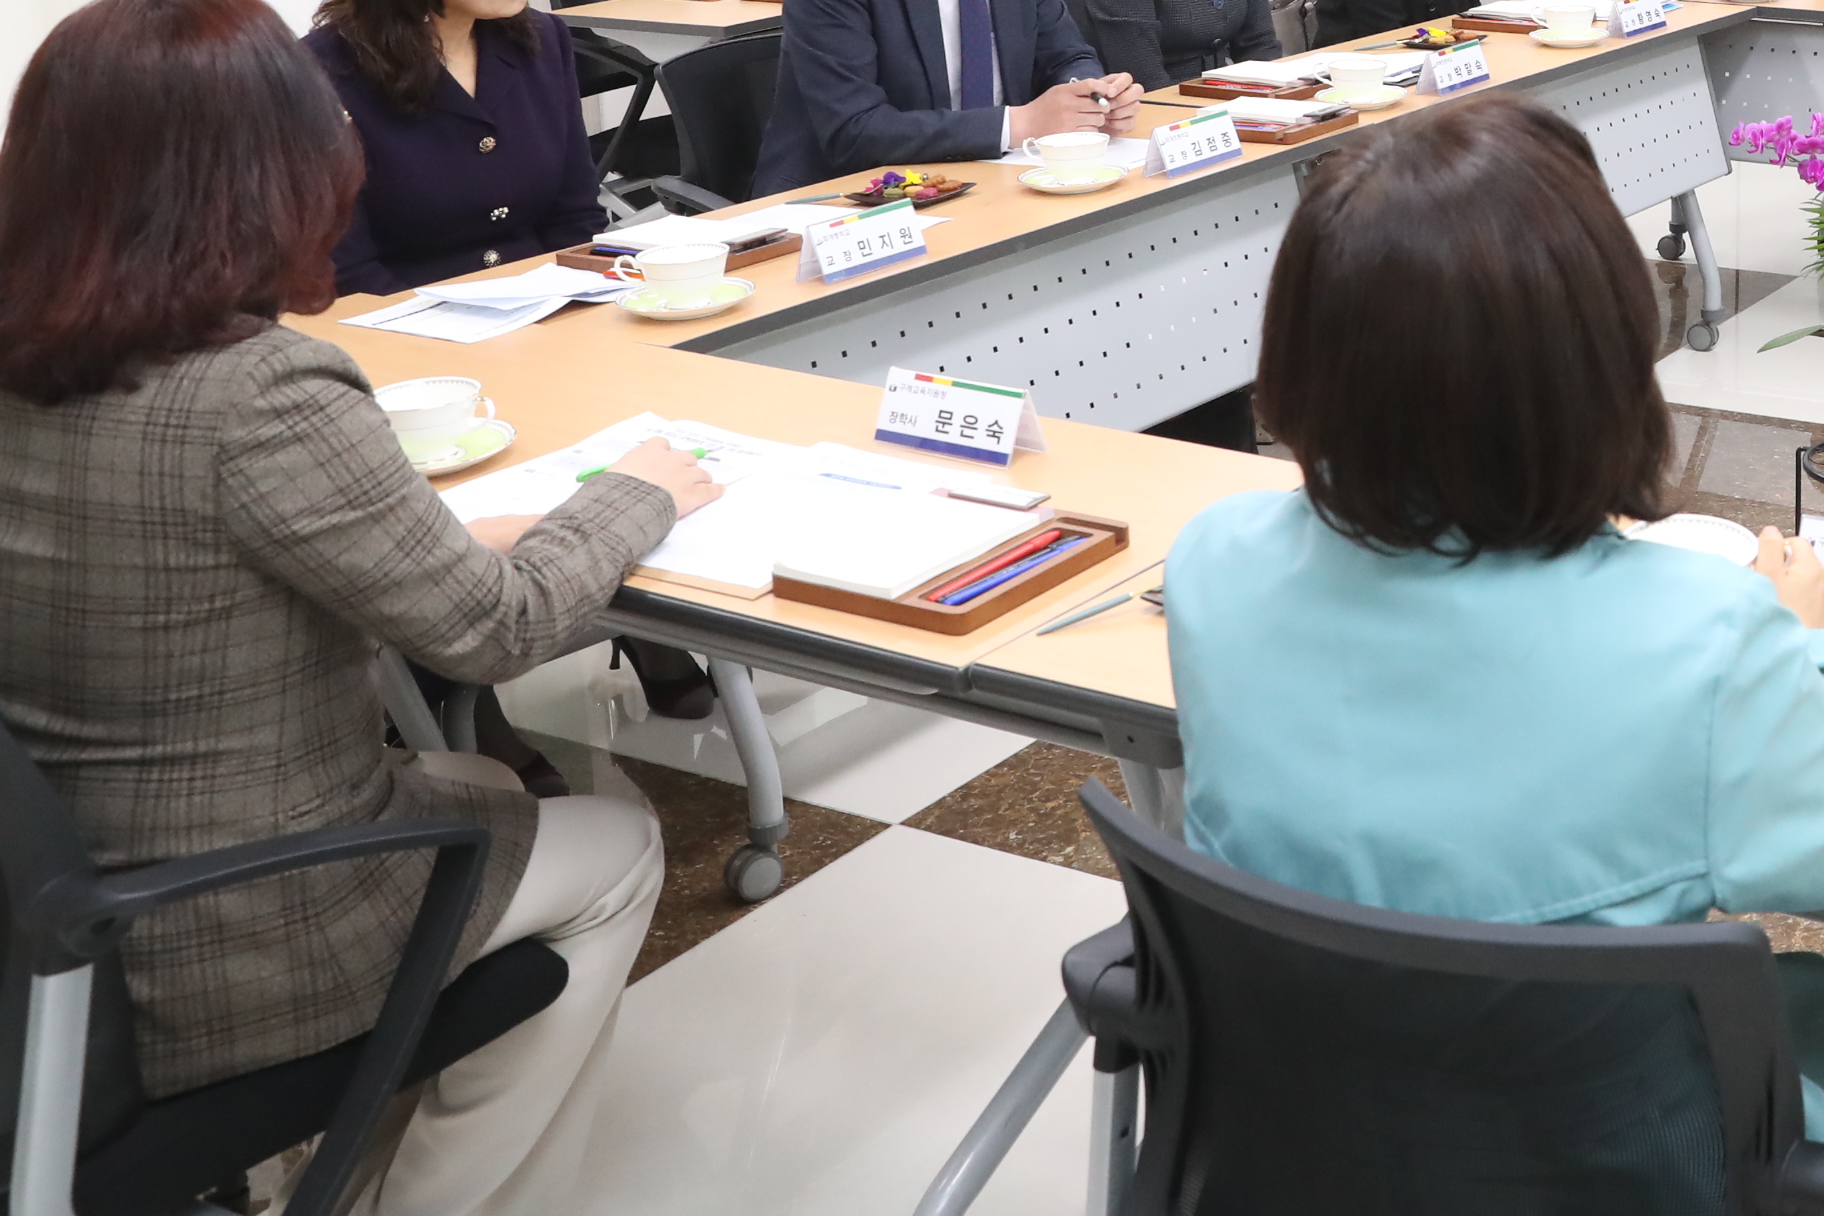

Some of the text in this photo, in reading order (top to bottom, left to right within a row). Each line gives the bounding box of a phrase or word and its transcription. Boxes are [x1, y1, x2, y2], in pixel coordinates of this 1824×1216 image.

[899, 383, 948, 401] 구례교육지원청
[888, 409, 1005, 445] 장학사 문은숙
